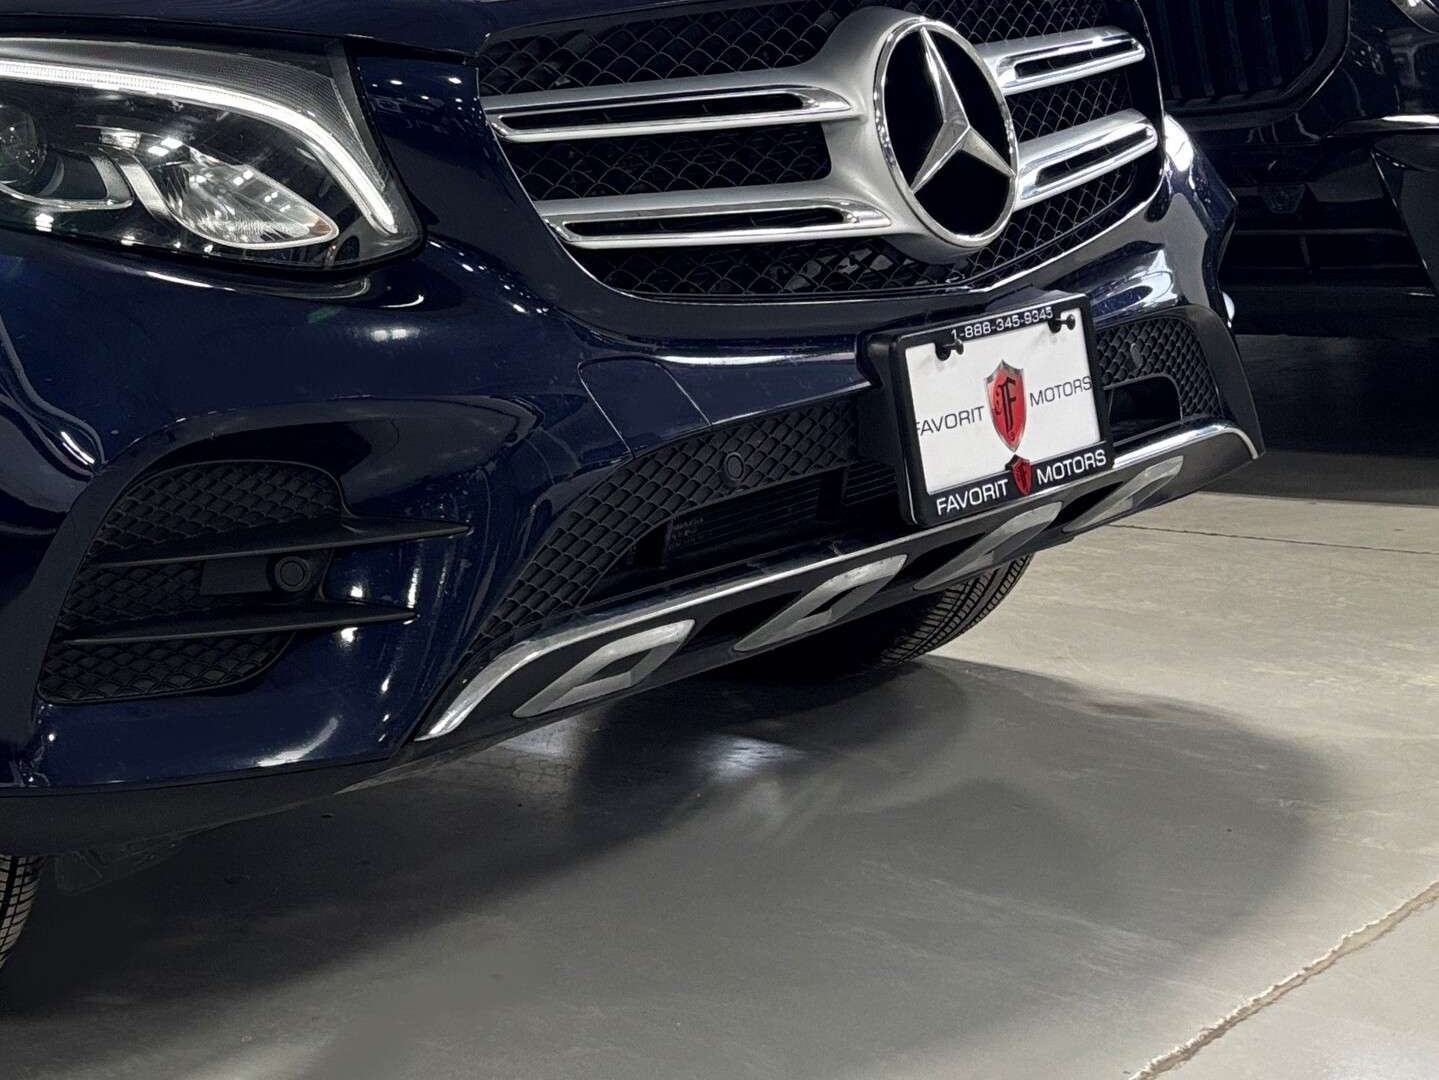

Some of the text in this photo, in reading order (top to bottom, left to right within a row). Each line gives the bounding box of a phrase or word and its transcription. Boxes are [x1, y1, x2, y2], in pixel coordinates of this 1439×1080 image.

[950, 307, 1053, 341] 1-888-345-9345
[1030, 376, 1093, 407] MOTORS
[936, 478, 1008, 515] FAVORIT
[1037, 450, 1107, 485] MOTORS
